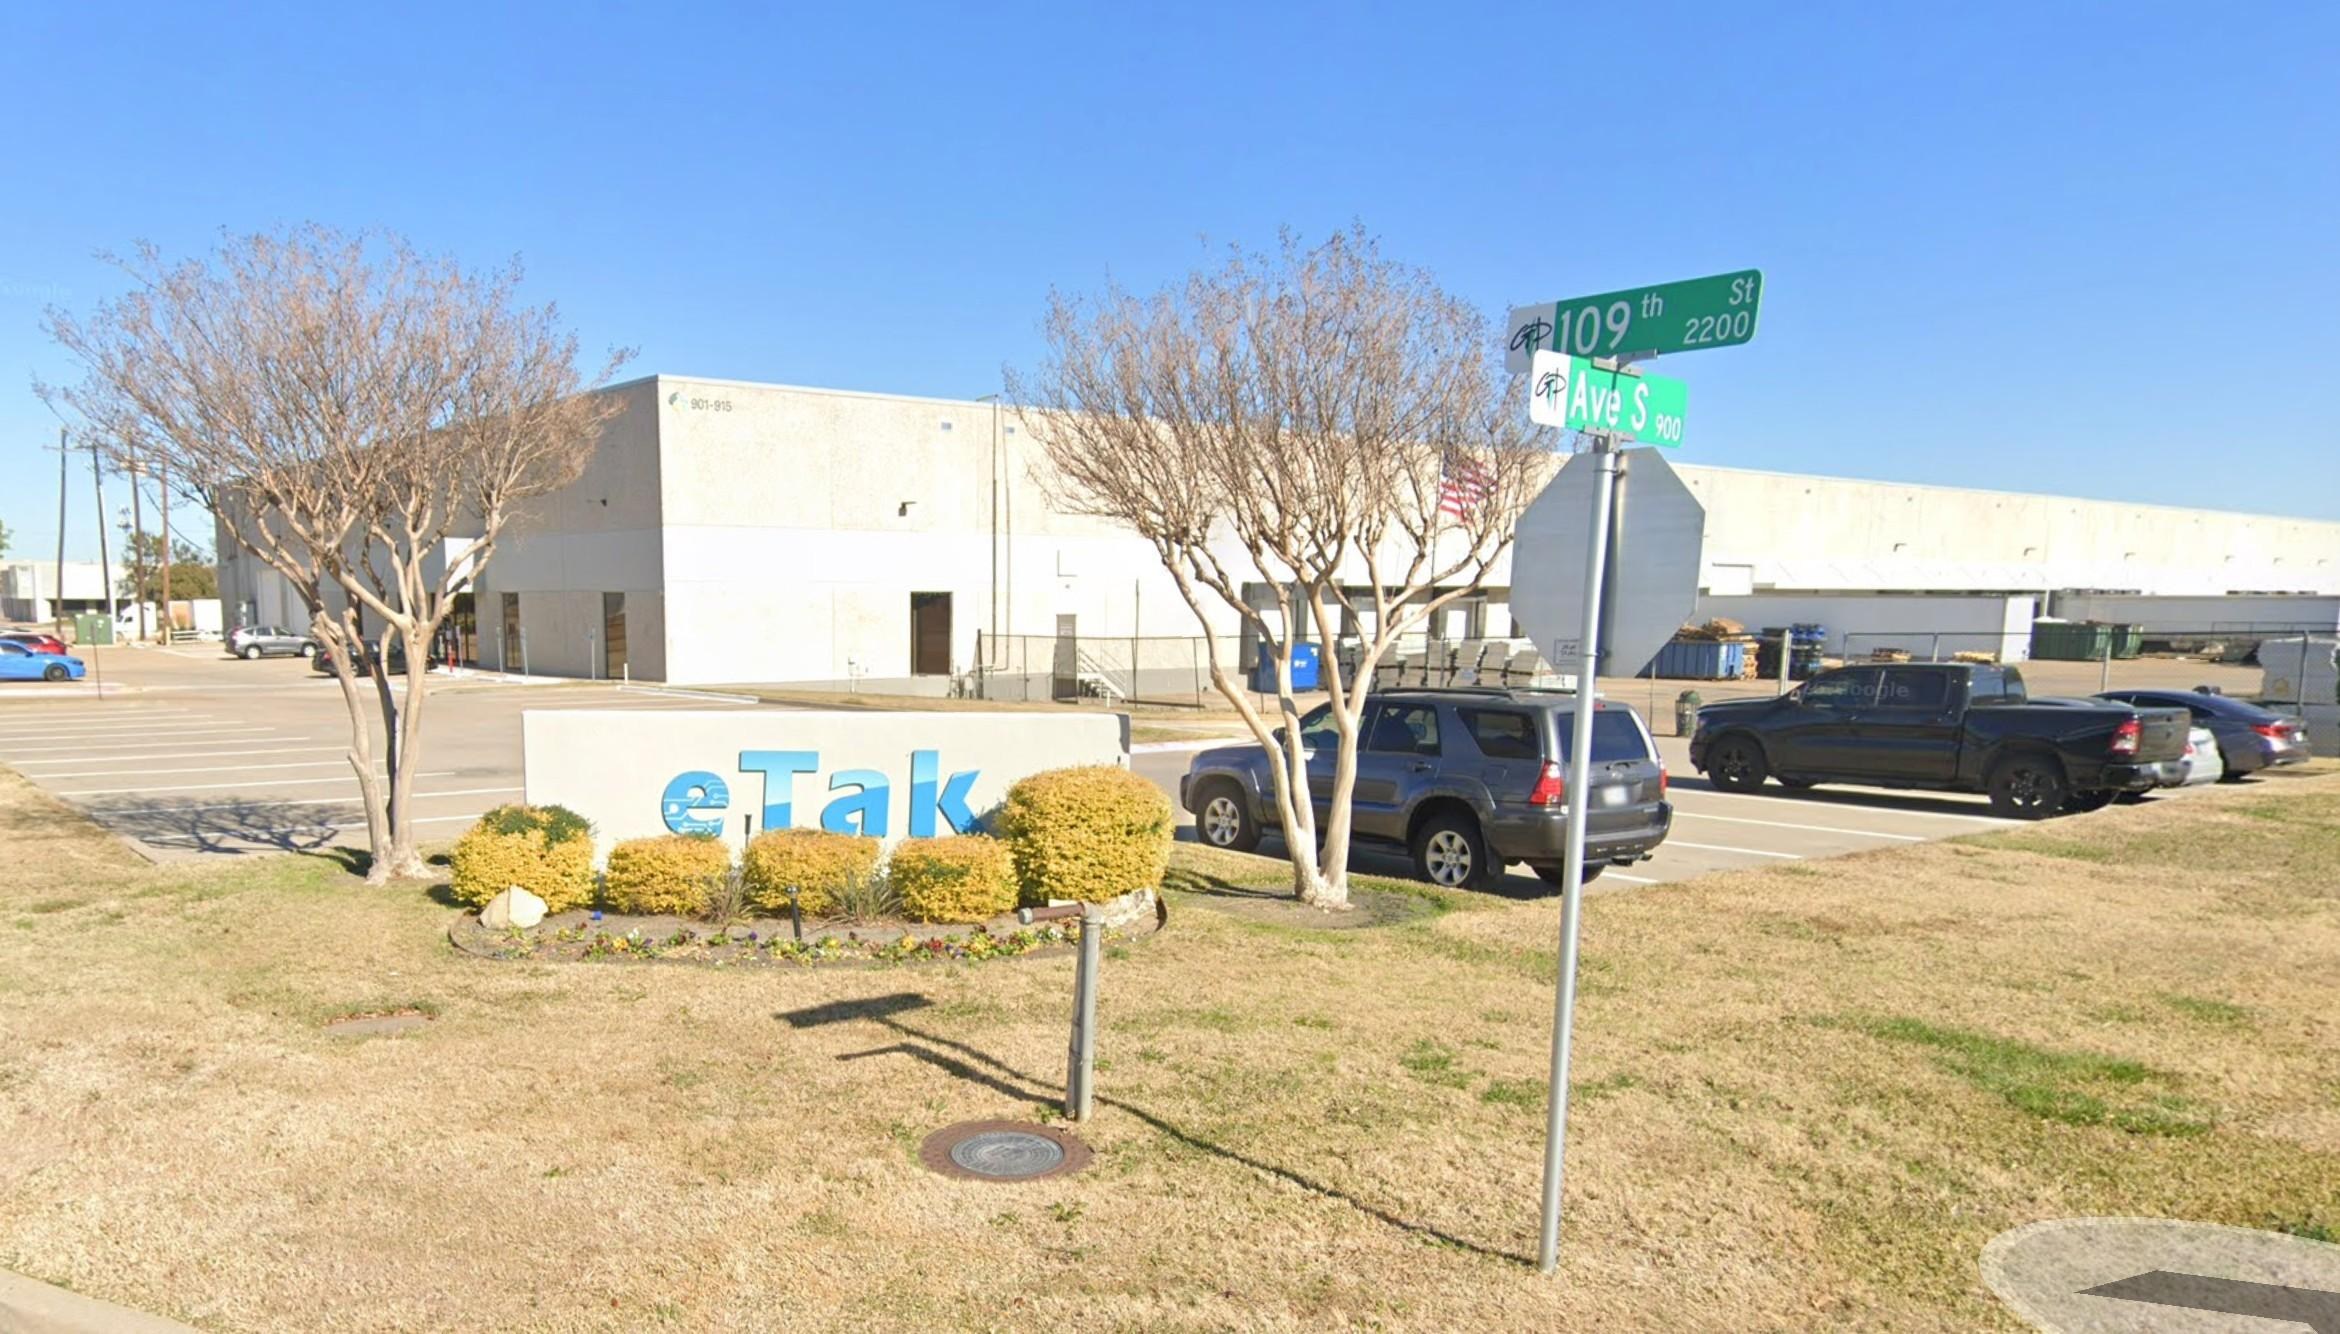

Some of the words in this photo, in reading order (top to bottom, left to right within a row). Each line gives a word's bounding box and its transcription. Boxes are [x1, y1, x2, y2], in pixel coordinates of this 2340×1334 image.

[1560, 301, 1631, 355] 109
[1641, 292, 1663, 318] th
[1729, 277, 1755, 305] St
[1683, 311, 1750, 345] 2200
[690, 398, 733, 412] 901-915
[1569, 370, 1622, 427] Ave
[1630, 383, 1650, 432] S
[1655, 415, 1681, 441] 900
[661, 749, 981, 838] eTak
